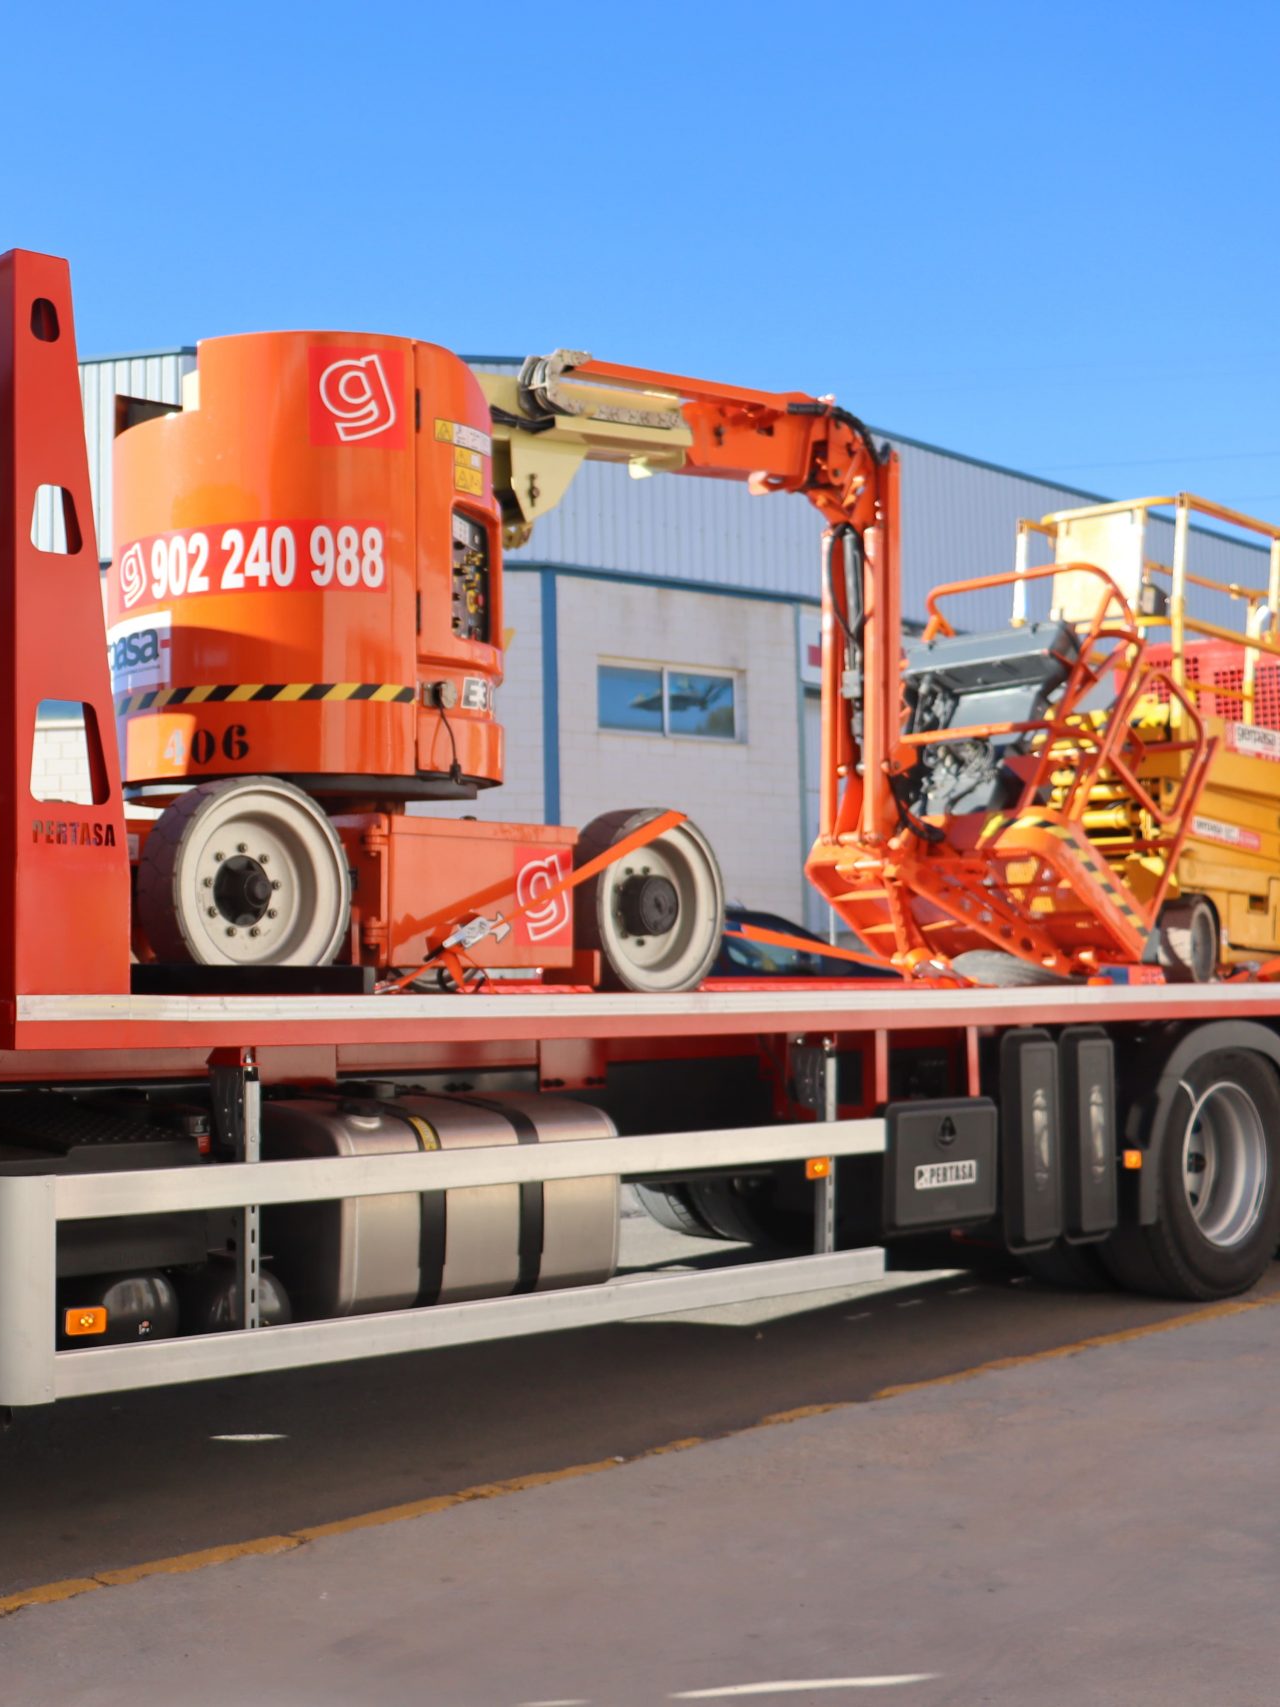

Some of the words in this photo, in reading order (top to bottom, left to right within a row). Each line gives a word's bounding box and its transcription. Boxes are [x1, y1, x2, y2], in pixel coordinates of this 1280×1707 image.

[151, 532, 210, 600] 902
[221, 526, 296, 590] 240
[310, 525, 385, 588] 988
[163, 724, 250, 767] 406
[32, 819, 116, 847] PERTASA
[929, 1163, 973, 1185] PERTASA
